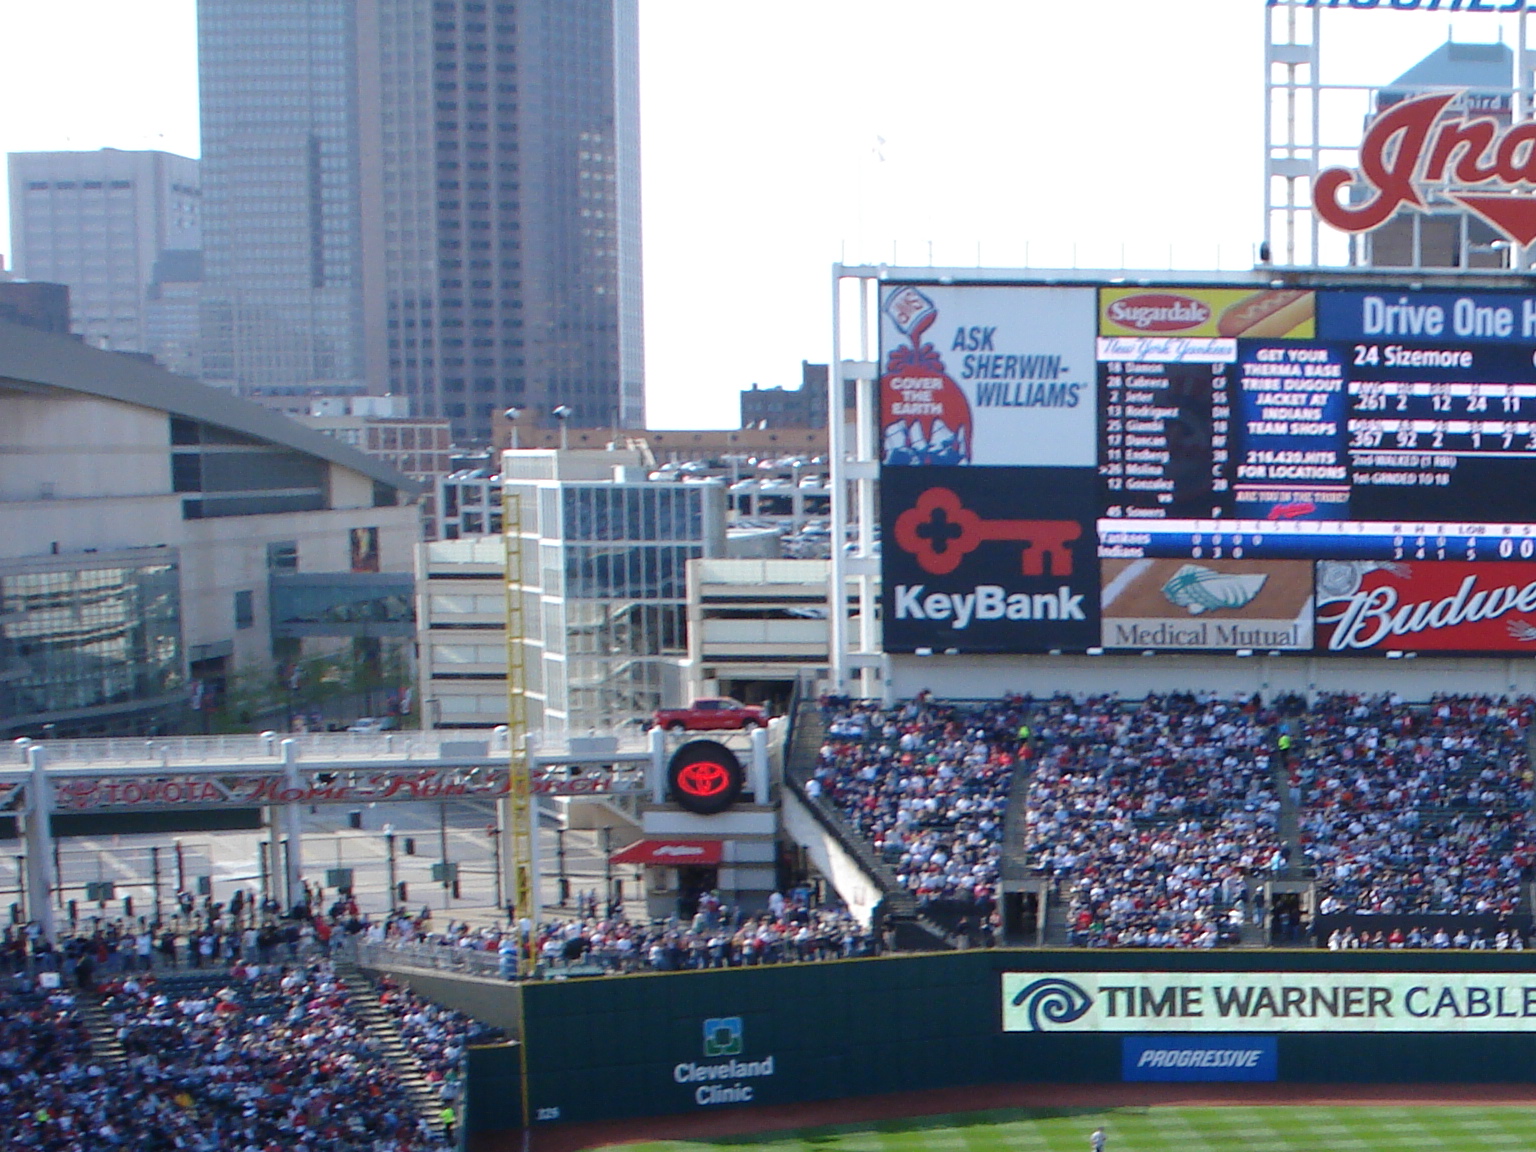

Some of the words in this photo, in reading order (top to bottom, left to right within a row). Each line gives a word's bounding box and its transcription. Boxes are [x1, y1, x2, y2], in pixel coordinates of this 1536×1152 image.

[1109, 295, 1210, 323] Sugardale
[1363, 296, 1443, 336] Drive
[1453, 299, 1514, 338] One
[952, 327, 996, 351] ASK
[1256, 348, 1286, 361] GET
[1287, 348, 1328, 362] YOUR
[1353, 345, 1380, 366] 24
[1384, 345, 1473, 368] Sizemore
[961, 355, 1070, 379] SHERWIN-
[890, 377, 943, 390] COVER
[901, 391, 933, 402] THE
[976, 383, 1080, 407] WILLIAMS
[1255, 392, 1308, 406] JACKET
[1309, 393, 1329, 406] AT
[1354, 394, 1387, 411] .261
[1396, 395, 1408, 411] 2
[1432, 395, 1452, 411] 12
[1466, 396, 1488, 412] 24
[1502, 397, 1521, 413] 11
[891, 403, 943, 415] EARTH
[1262, 407, 1322, 420] INDIANS
[1246, 421, 1288, 435] TEAM
[1289, 421, 1337, 436] SHOPS
[1349, 431, 1384, 447] .367
[1396, 431, 1418, 448] 92
[1432, 432, 1444, 448] 2
[1471, 433, 1481, 449] 1
[1502, 432, 1513, 449] 7
[1237, 465, 1267, 478] FOR
[1268, 465, 1347, 479] LOCATIONS
[1500, 538, 1513, 558] 0
[1520, 539, 1534, 558] 0
[895, 585, 1086, 629] KeyBank
[1116, 623, 1207, 646] Medical
[1216, 624, 1299, 646] Mutual
[105, 782, 220, 803] TOYOTA
[1100, 986, 1201, 1018] TIME
[1213, 986, 1395, 1018] WARNER
[1137, 1049, 1266, 1068] PROGRESSIVE
[673, 1056, 774, 1084] Cleveland
[695, 1083, 754, 1105] Clinic
